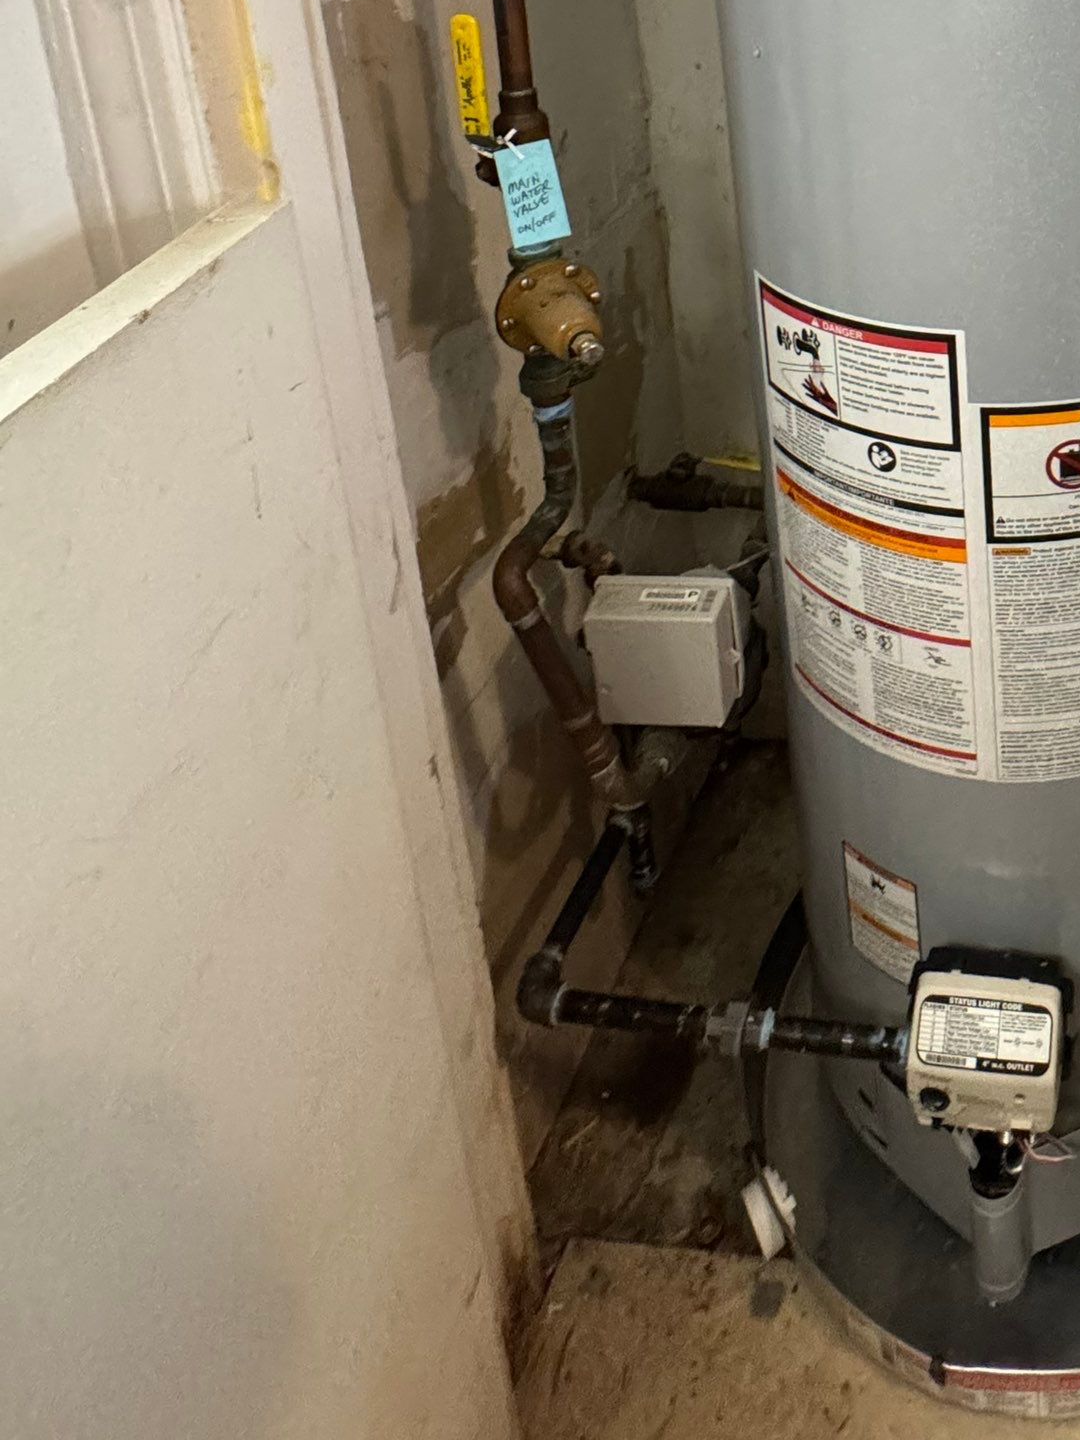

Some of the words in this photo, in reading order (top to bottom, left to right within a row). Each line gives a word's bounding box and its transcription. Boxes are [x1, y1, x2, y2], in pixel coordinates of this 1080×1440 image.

[508, 176, 540, 195] MAIN
[510, 179, 553, 206] WATER
[513, 191, 549, 218] VALVE
[822, 320, 864, 340] DANGER
[949, 997, 976, 1007] STATUS
[978, 999, 1000, 1009] LIGHT
[1001, 1001, 1023, 1011] CODE
[1006, 1061, 1034, 1072] OUTLET
